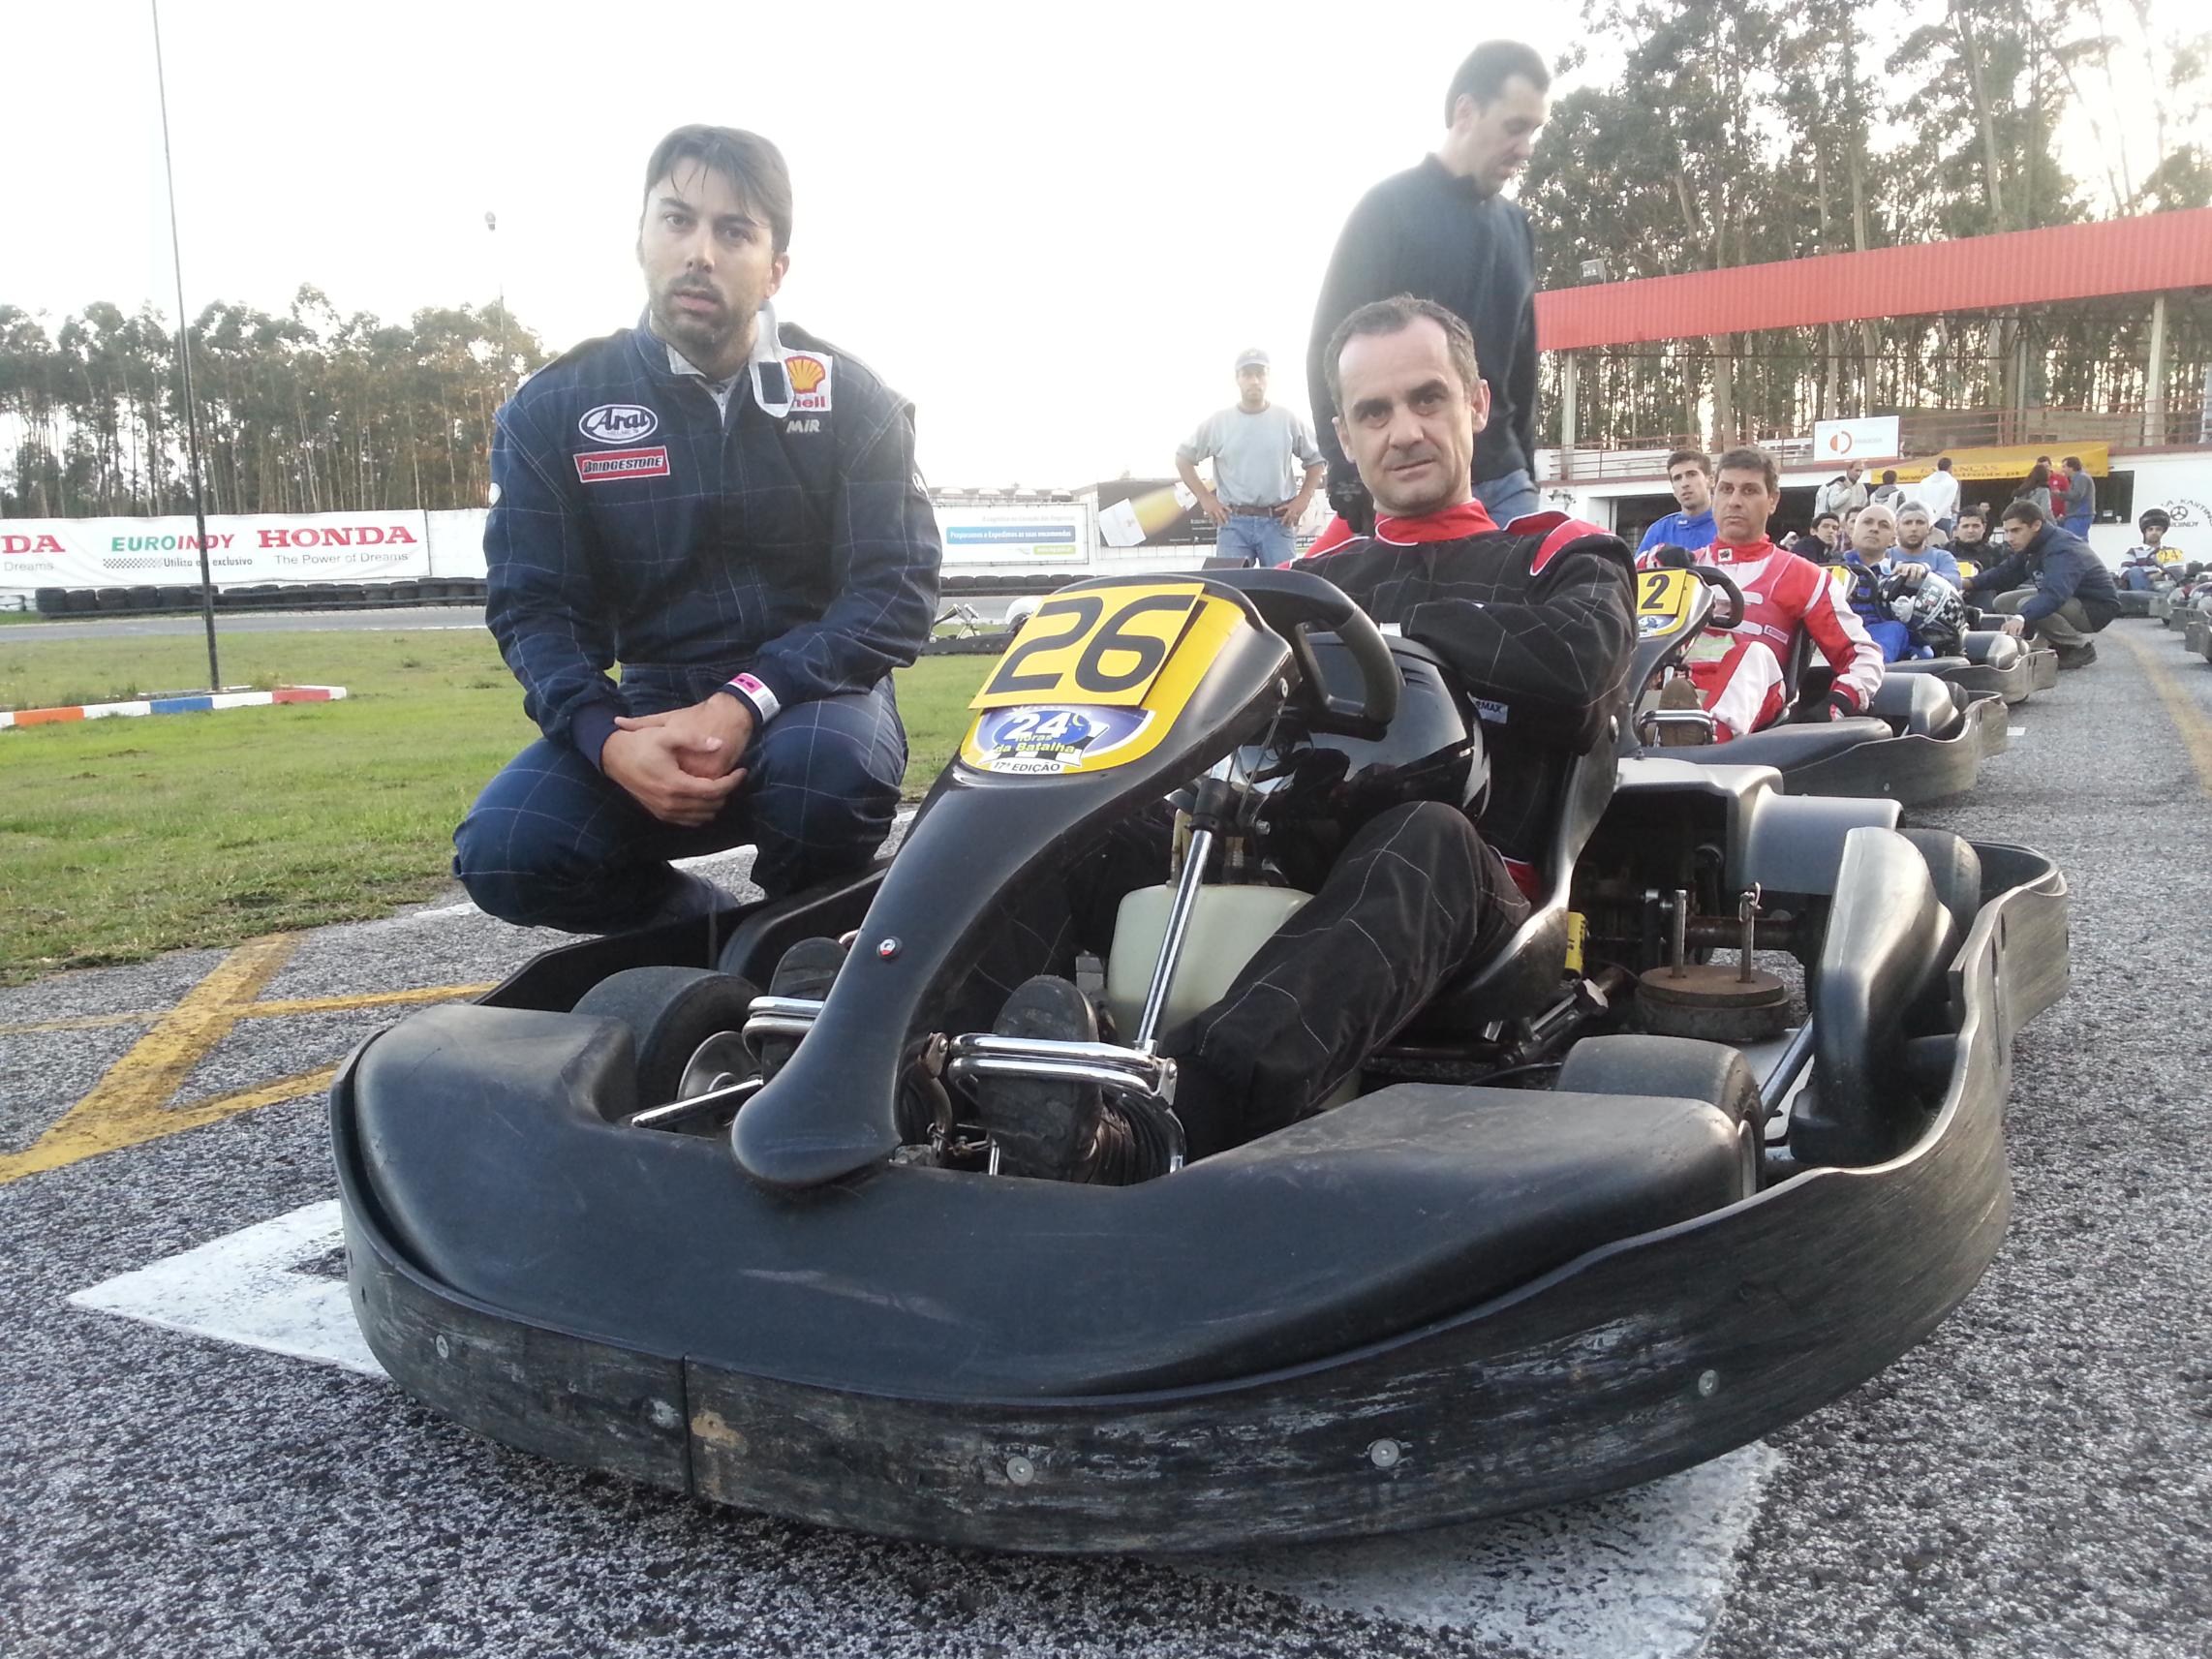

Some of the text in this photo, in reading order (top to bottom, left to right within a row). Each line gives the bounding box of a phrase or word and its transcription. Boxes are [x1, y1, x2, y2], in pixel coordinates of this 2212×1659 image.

[586, 408, 649, 431] Arai
[583, 457, 662, 473] BRIDGESTONE
[257, 526, 417, 548] HONDA
[212, 556, 253, 567] exclusivo
[274, 551, 409, 565] The Power of Dreams
[4, 561, 54, 571] Dreams
[984, 594, 1196, 694] 26
[1003, 712, 1072, 740] 24
[994, 742, 1077, 754] da Batalha
[1012, 761, 1060, 773] EDIÇÃO
